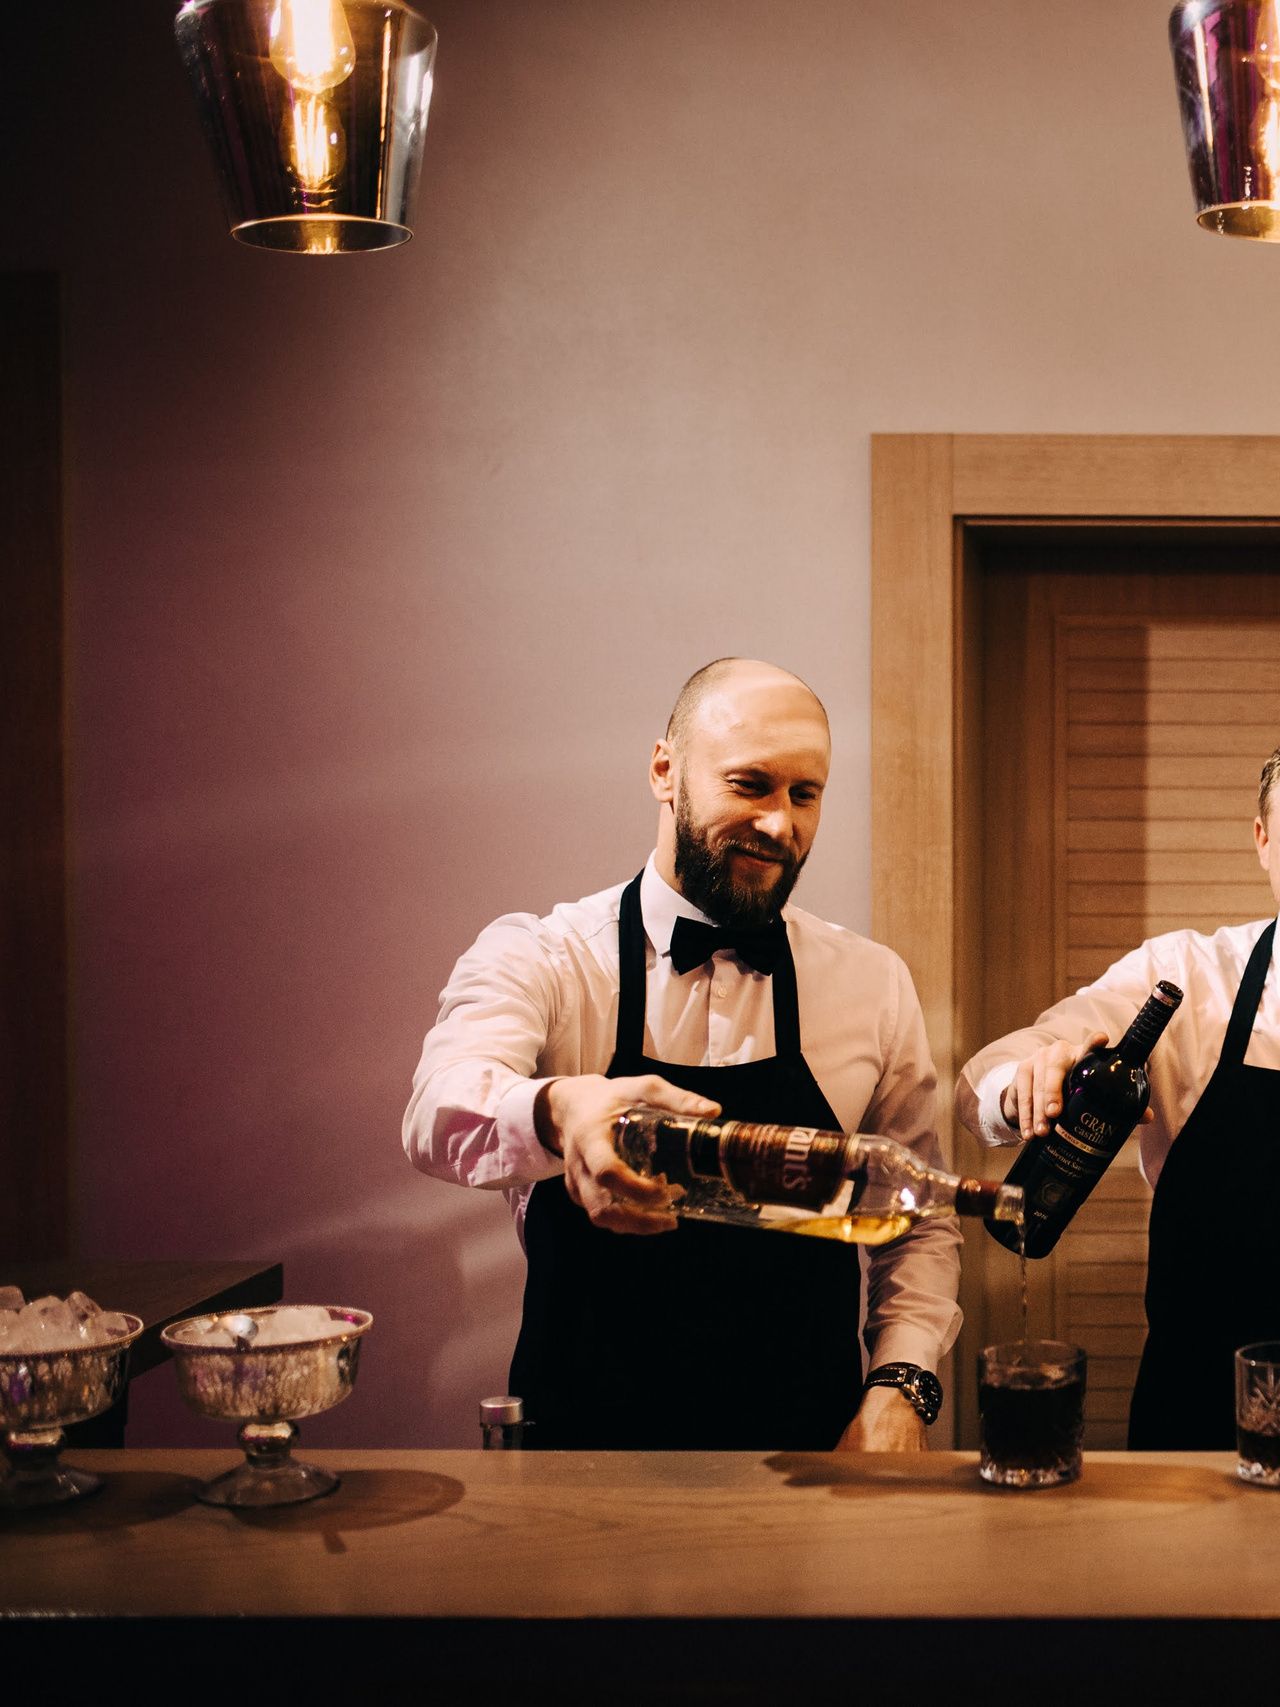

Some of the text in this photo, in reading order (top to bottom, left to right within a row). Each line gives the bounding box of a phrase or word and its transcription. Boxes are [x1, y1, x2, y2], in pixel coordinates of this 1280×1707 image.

[1074, 1125, 1107, 1146] castillo
[1081, 1112, 1116, 1136] GRAN
[783, 1127, 818, 1190] rant's
